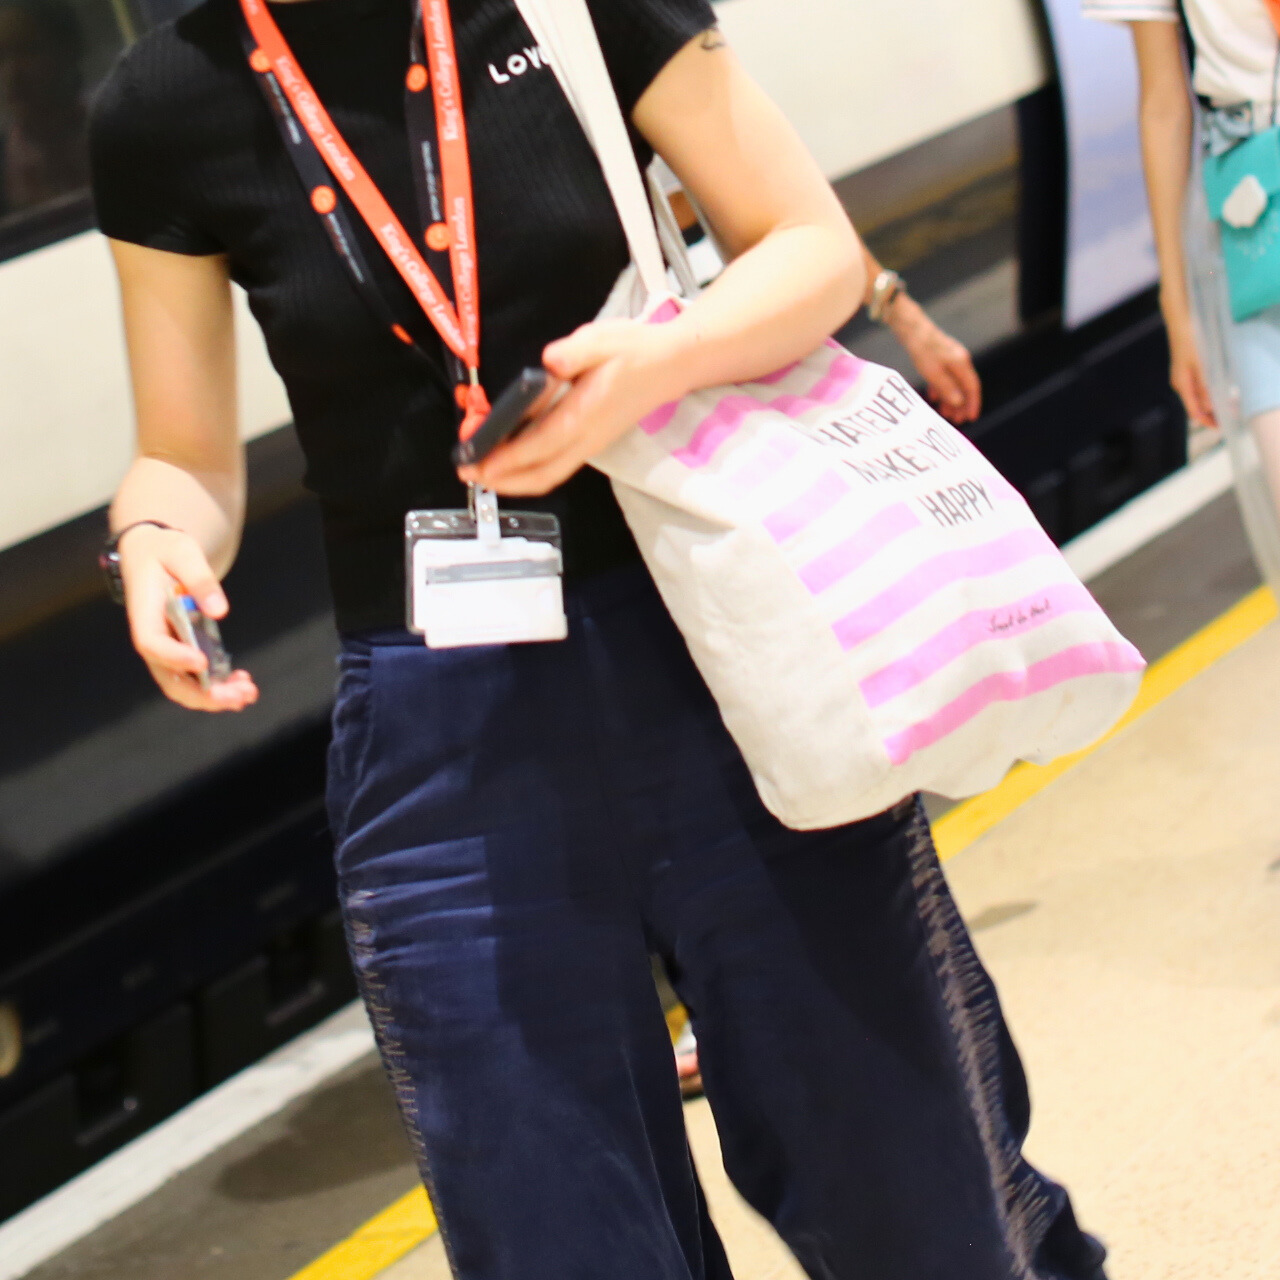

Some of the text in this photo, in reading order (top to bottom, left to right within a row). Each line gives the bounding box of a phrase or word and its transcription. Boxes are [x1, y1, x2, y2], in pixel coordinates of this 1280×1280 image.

[429, 0, 460, 141] King's College London
[295, 91, 326, 135] College
[321, 133, 356, 182] London
[450, 196, 469, 250] London
[379, 222, 468, 351] King's College London
[916, 477, 995, 528] HAPPY
